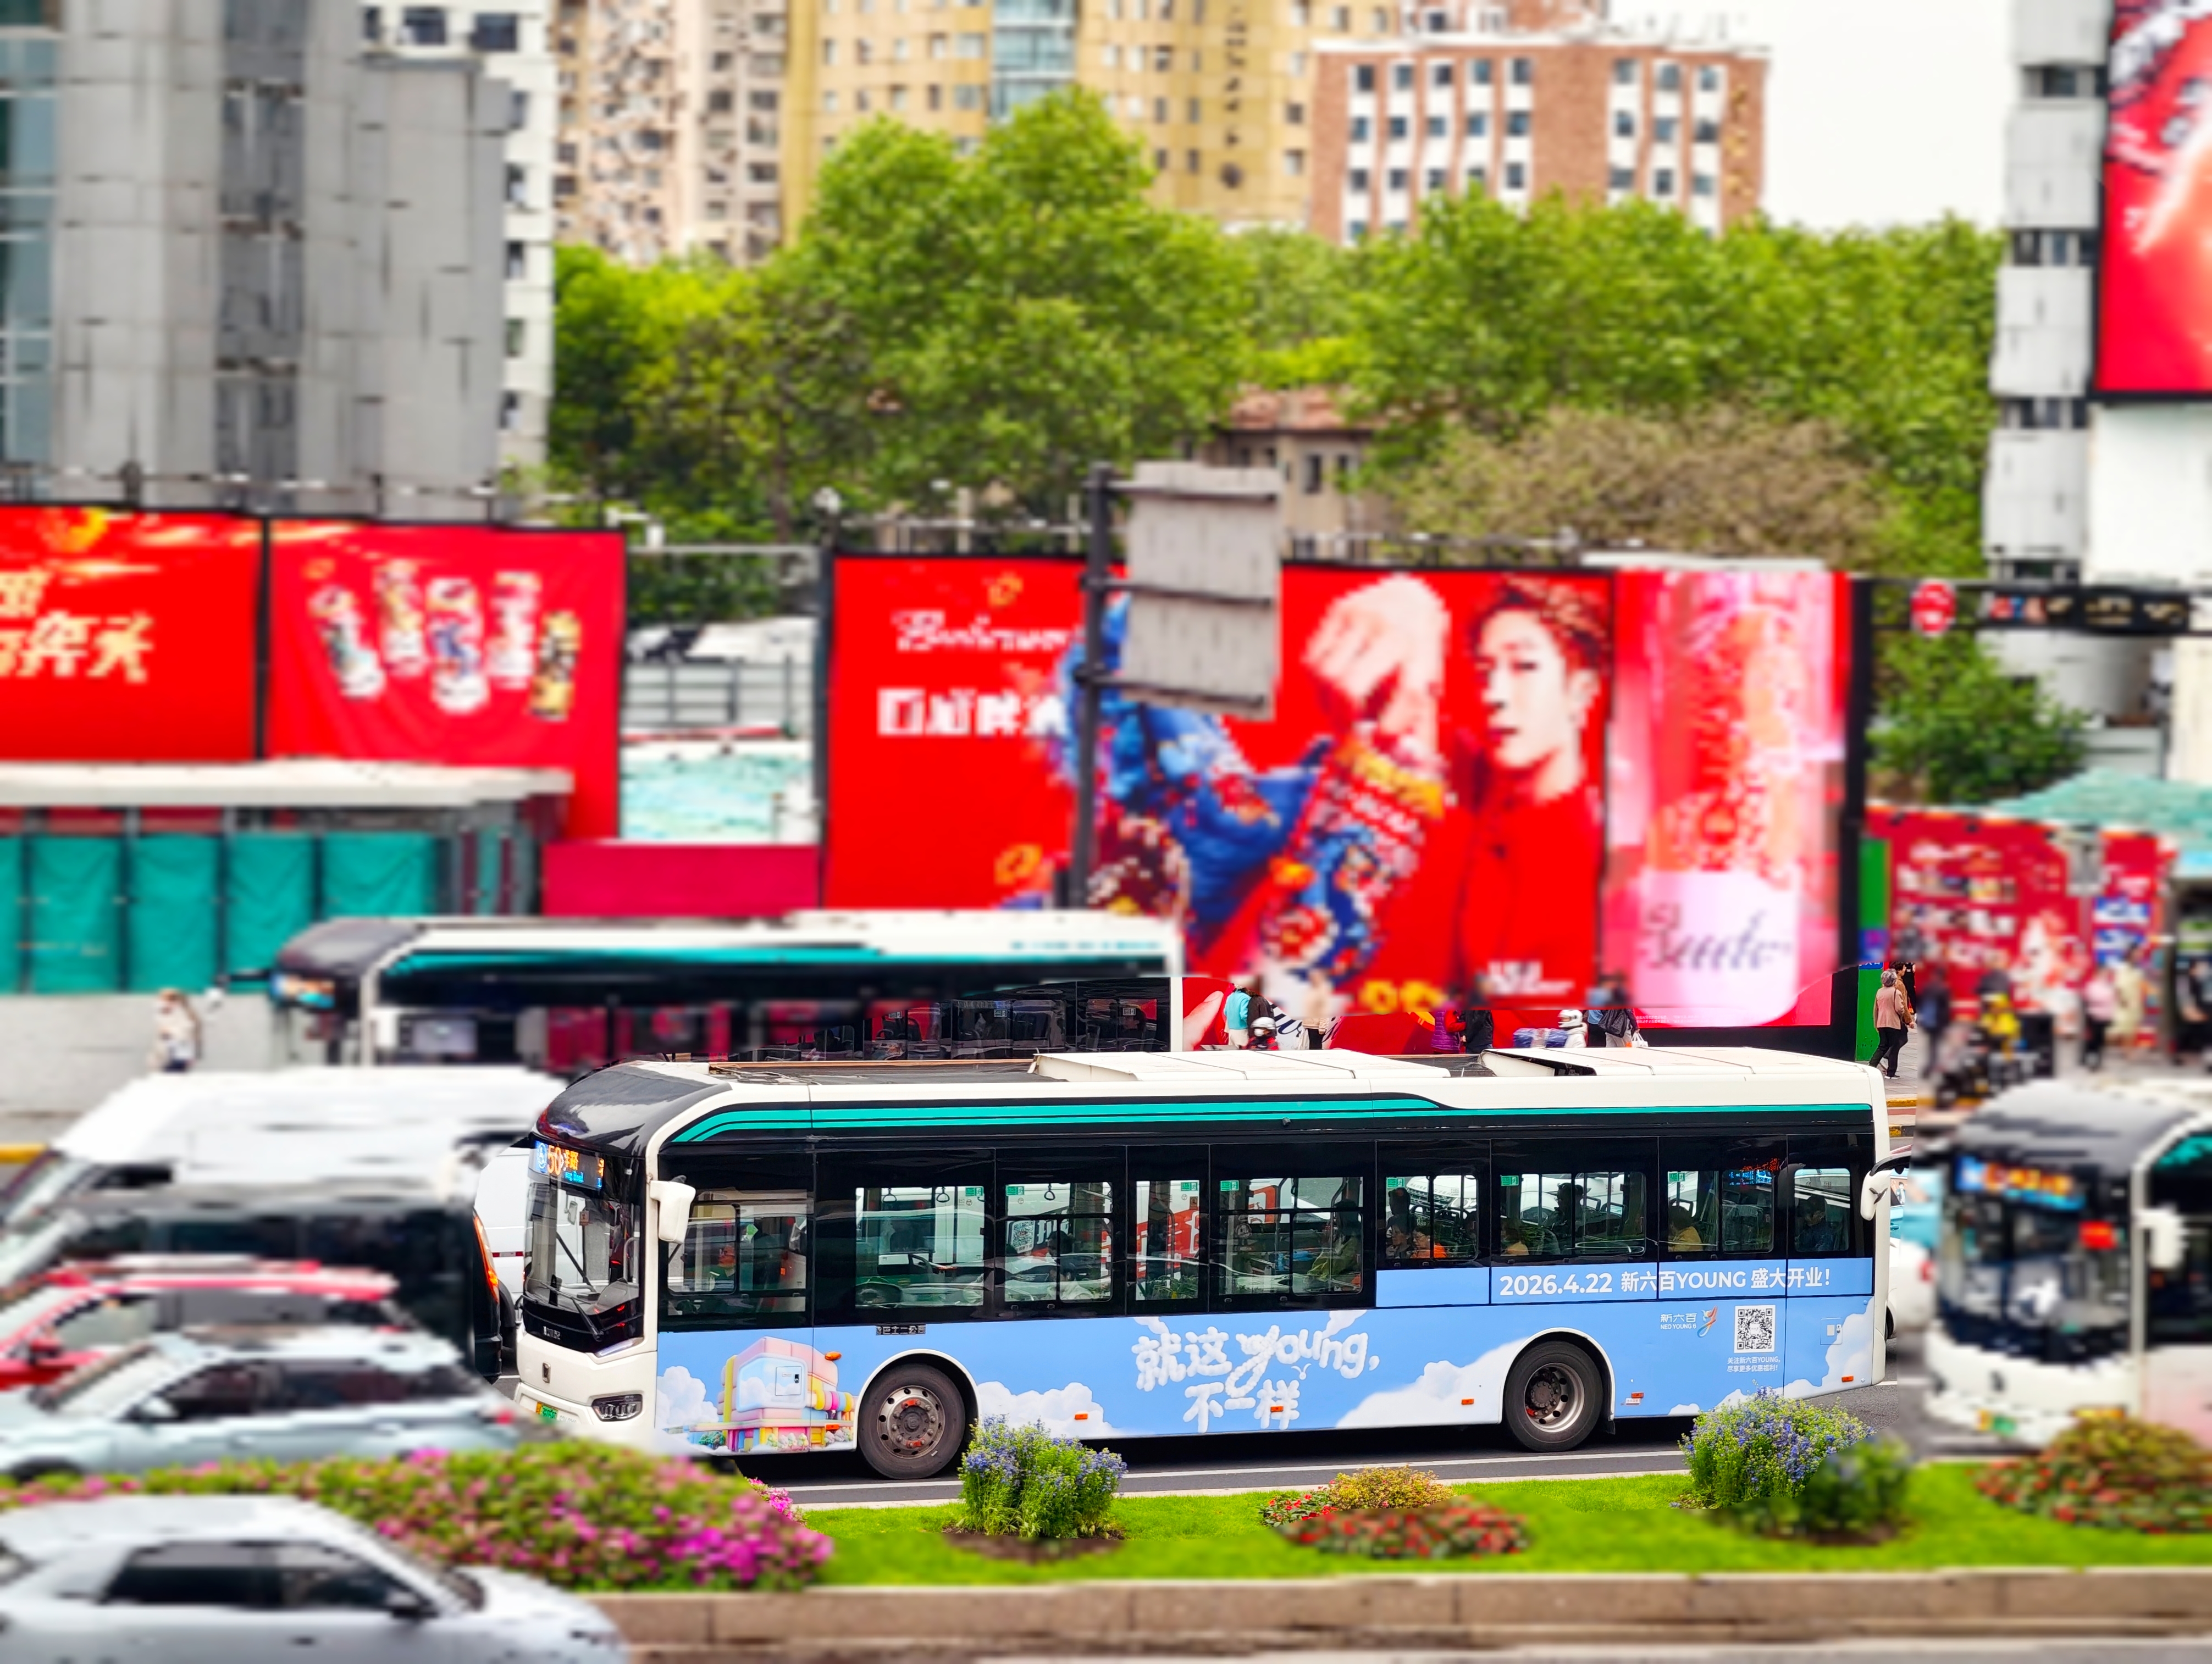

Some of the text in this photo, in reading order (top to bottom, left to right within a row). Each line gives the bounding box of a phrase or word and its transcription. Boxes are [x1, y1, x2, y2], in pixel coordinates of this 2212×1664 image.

[1500, 1266, 1831, 1296] 2026.4.22 新六百YOUNG 盛大开业！
[1660, 1313, 1697, 1323] 新六百
[1182, 1379, 1301, 1433] 不一样
